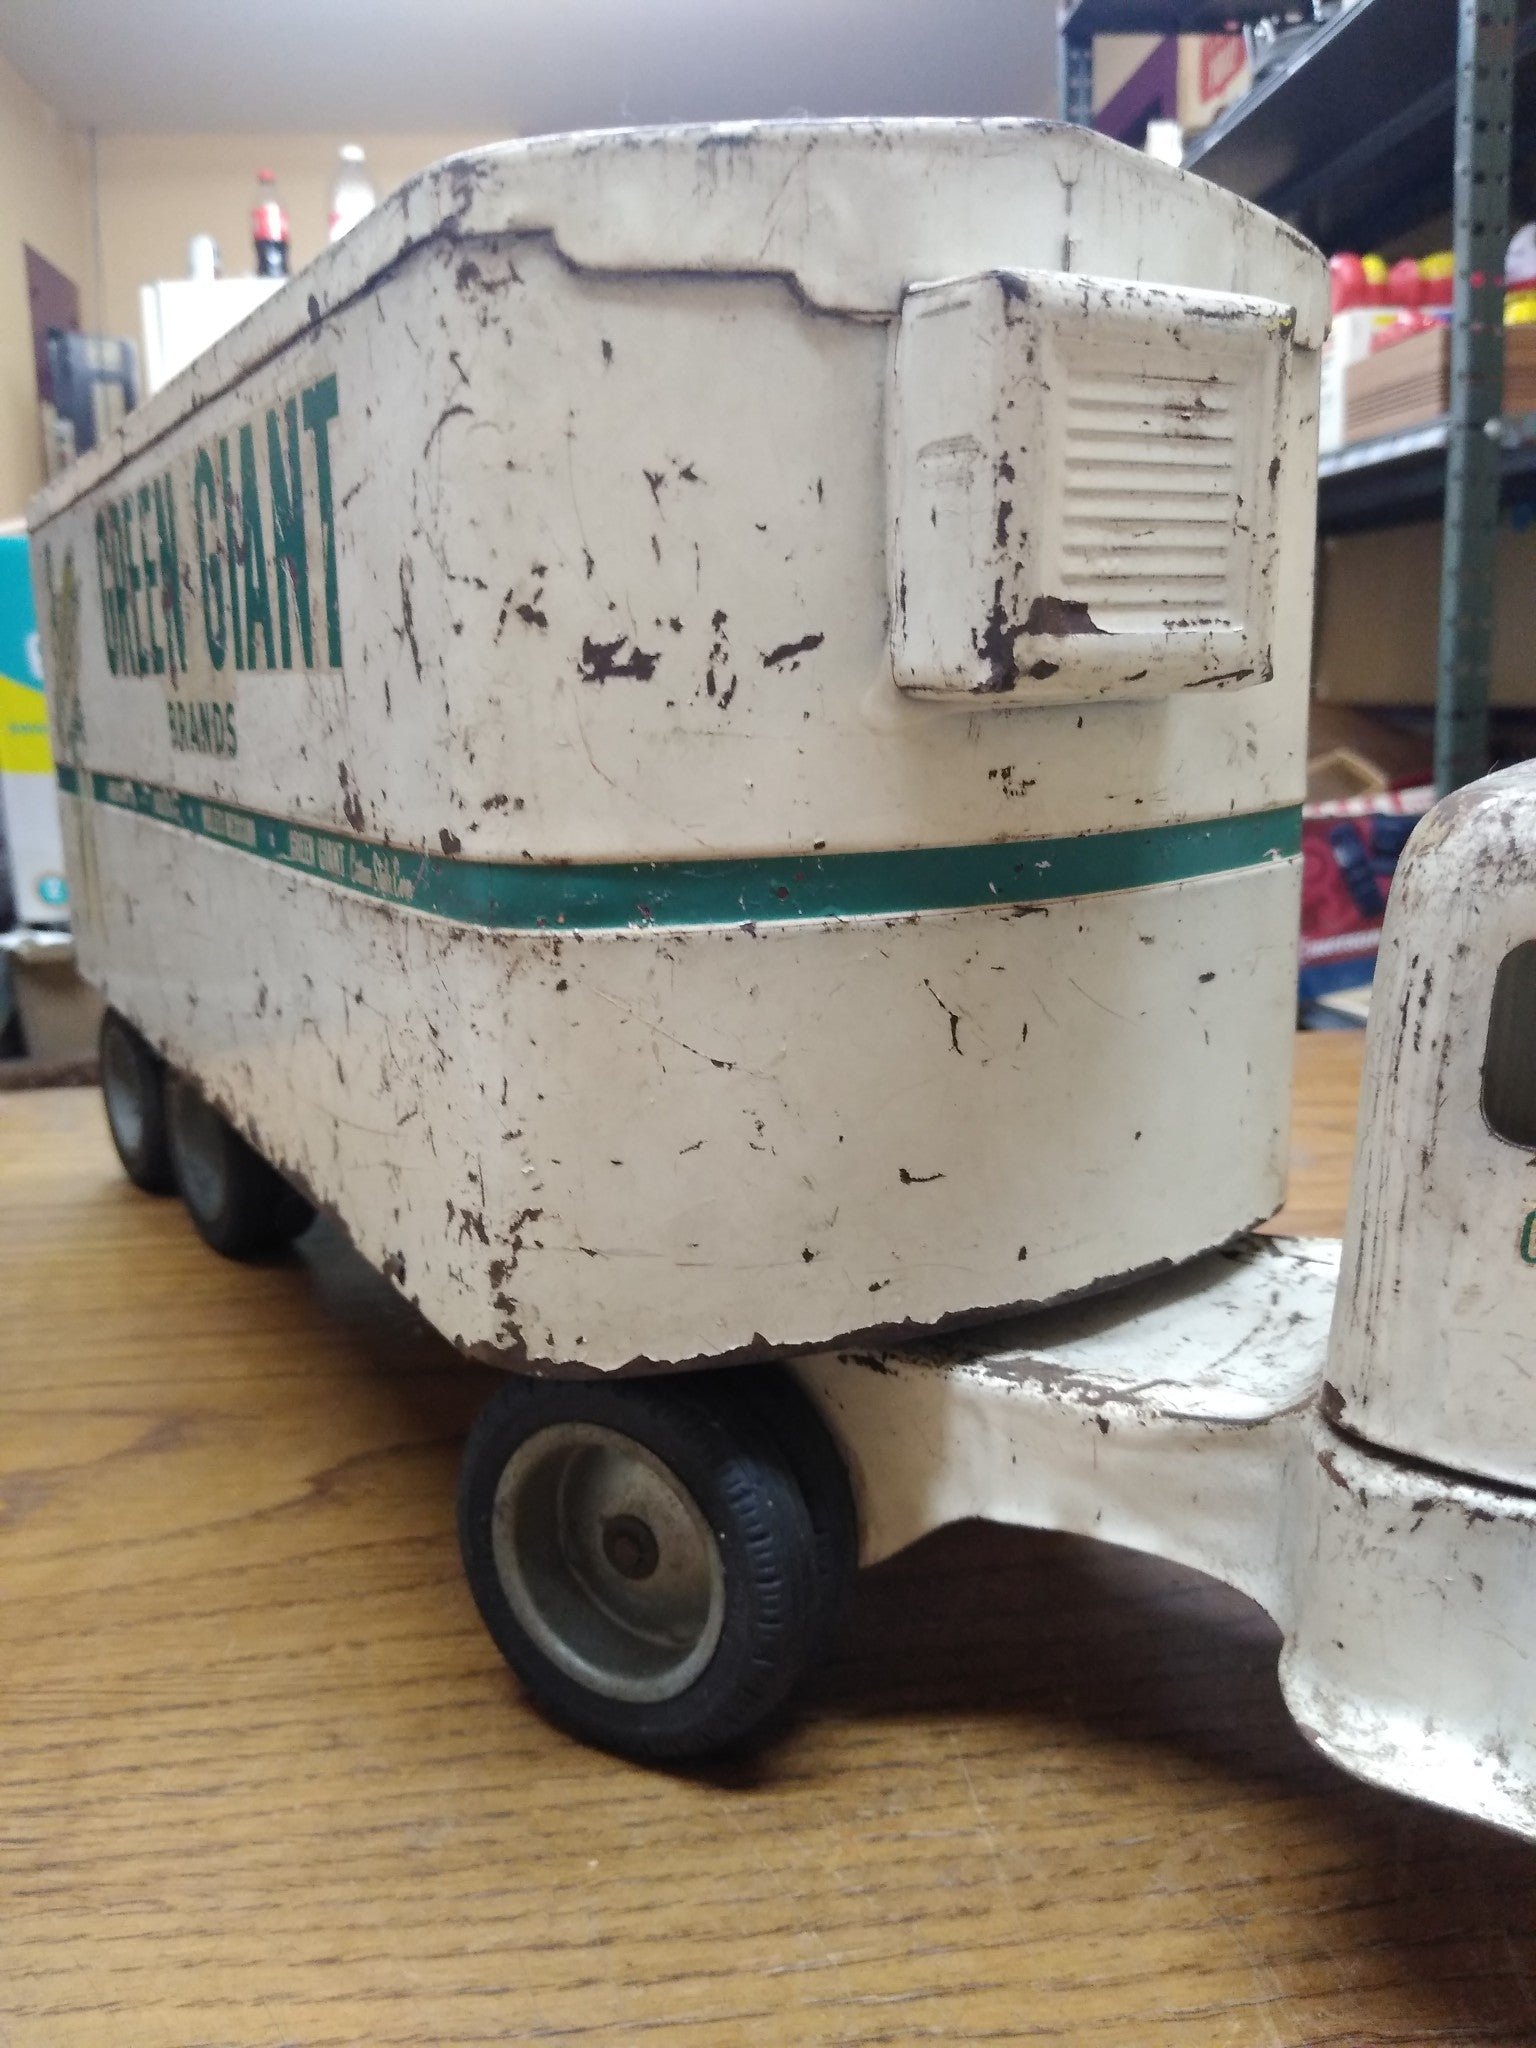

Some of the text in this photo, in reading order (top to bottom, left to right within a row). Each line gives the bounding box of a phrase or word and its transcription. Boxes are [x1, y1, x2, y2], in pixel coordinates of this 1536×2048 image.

[95, 373, 343, 677] GREEN GIANT
[167, 701, 238, 758] BRANDS
